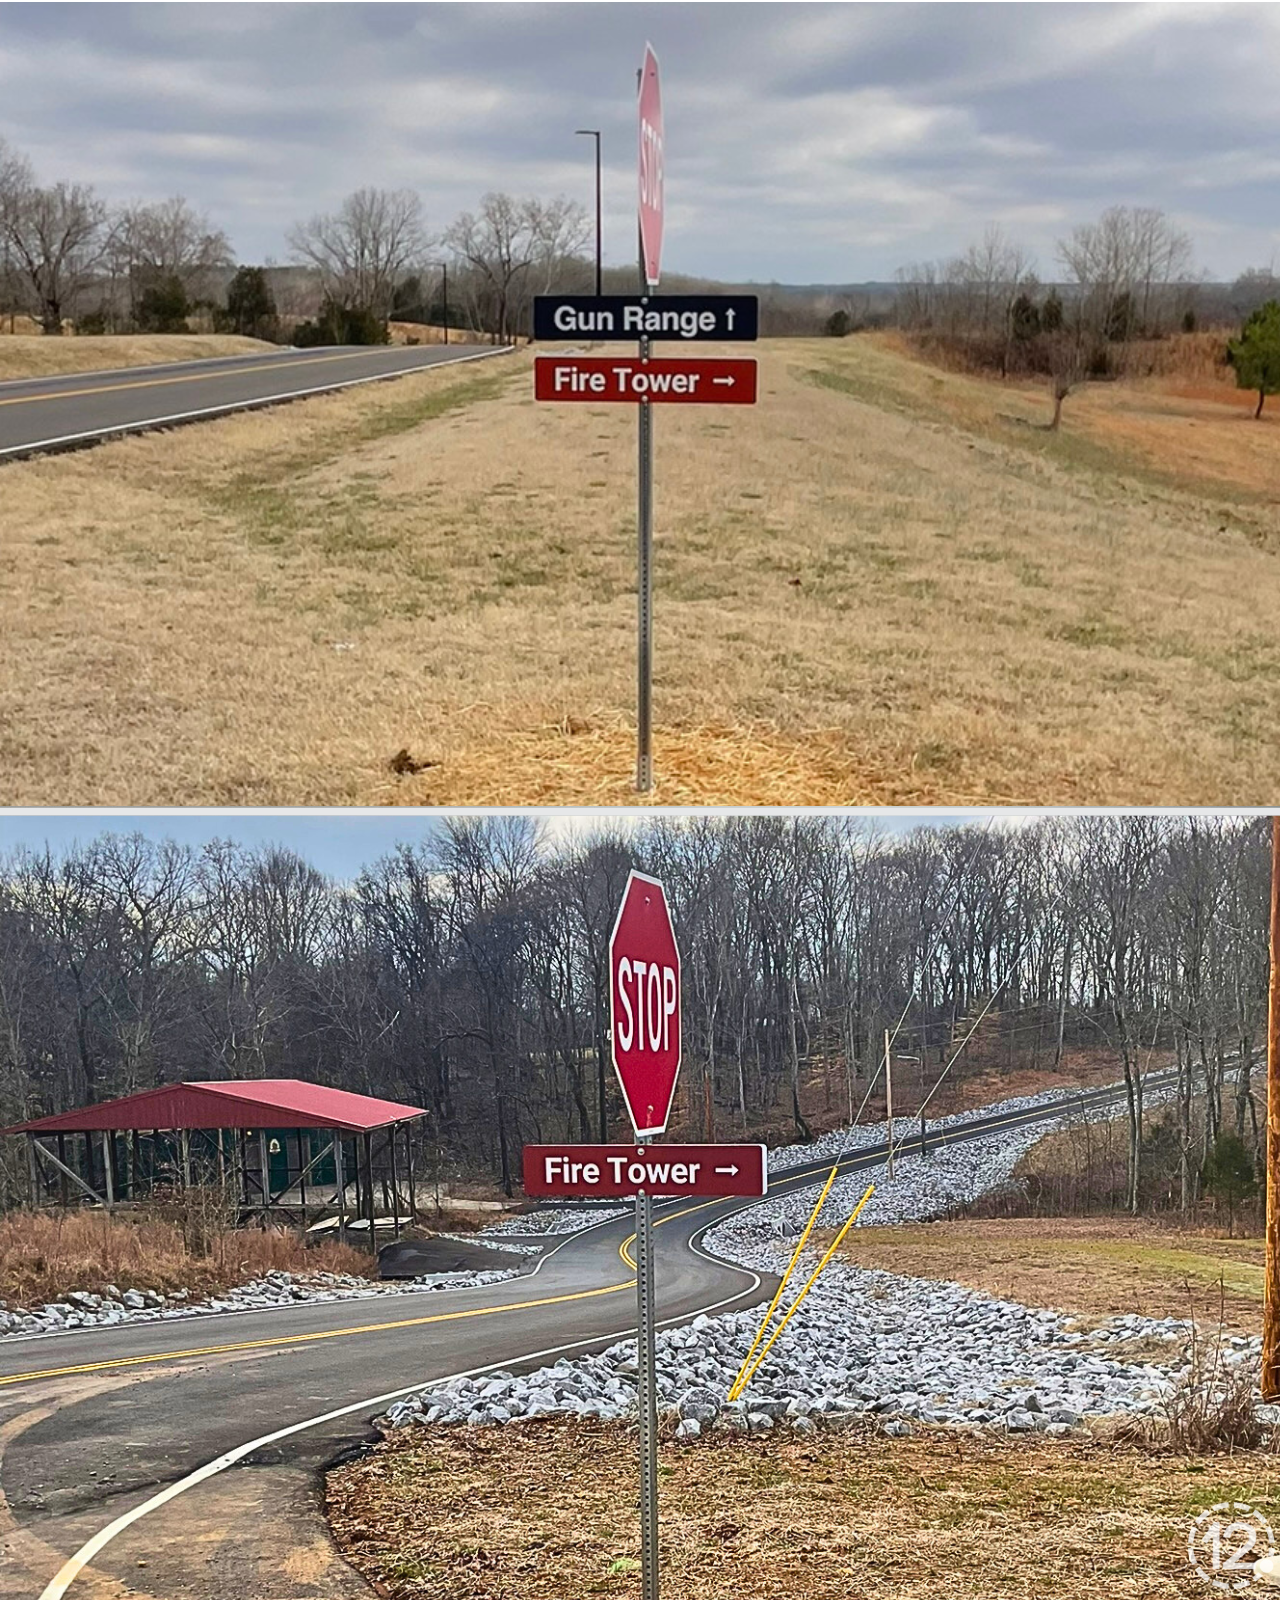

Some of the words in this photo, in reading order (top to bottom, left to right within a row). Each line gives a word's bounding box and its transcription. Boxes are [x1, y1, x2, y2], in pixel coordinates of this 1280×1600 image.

[641, 118, 663, 211] STOP
[554, 305, 614, 332] Gun
[623, 305, 716, 338] Range
[554, 366, 606, 392] Fire
[612, 367, 700, 393] Tower
[617, 956, 676, 1052] STOP
[545, 1156, 600, 1184] Fire
[606, 1156, 700, 1184] Tower
